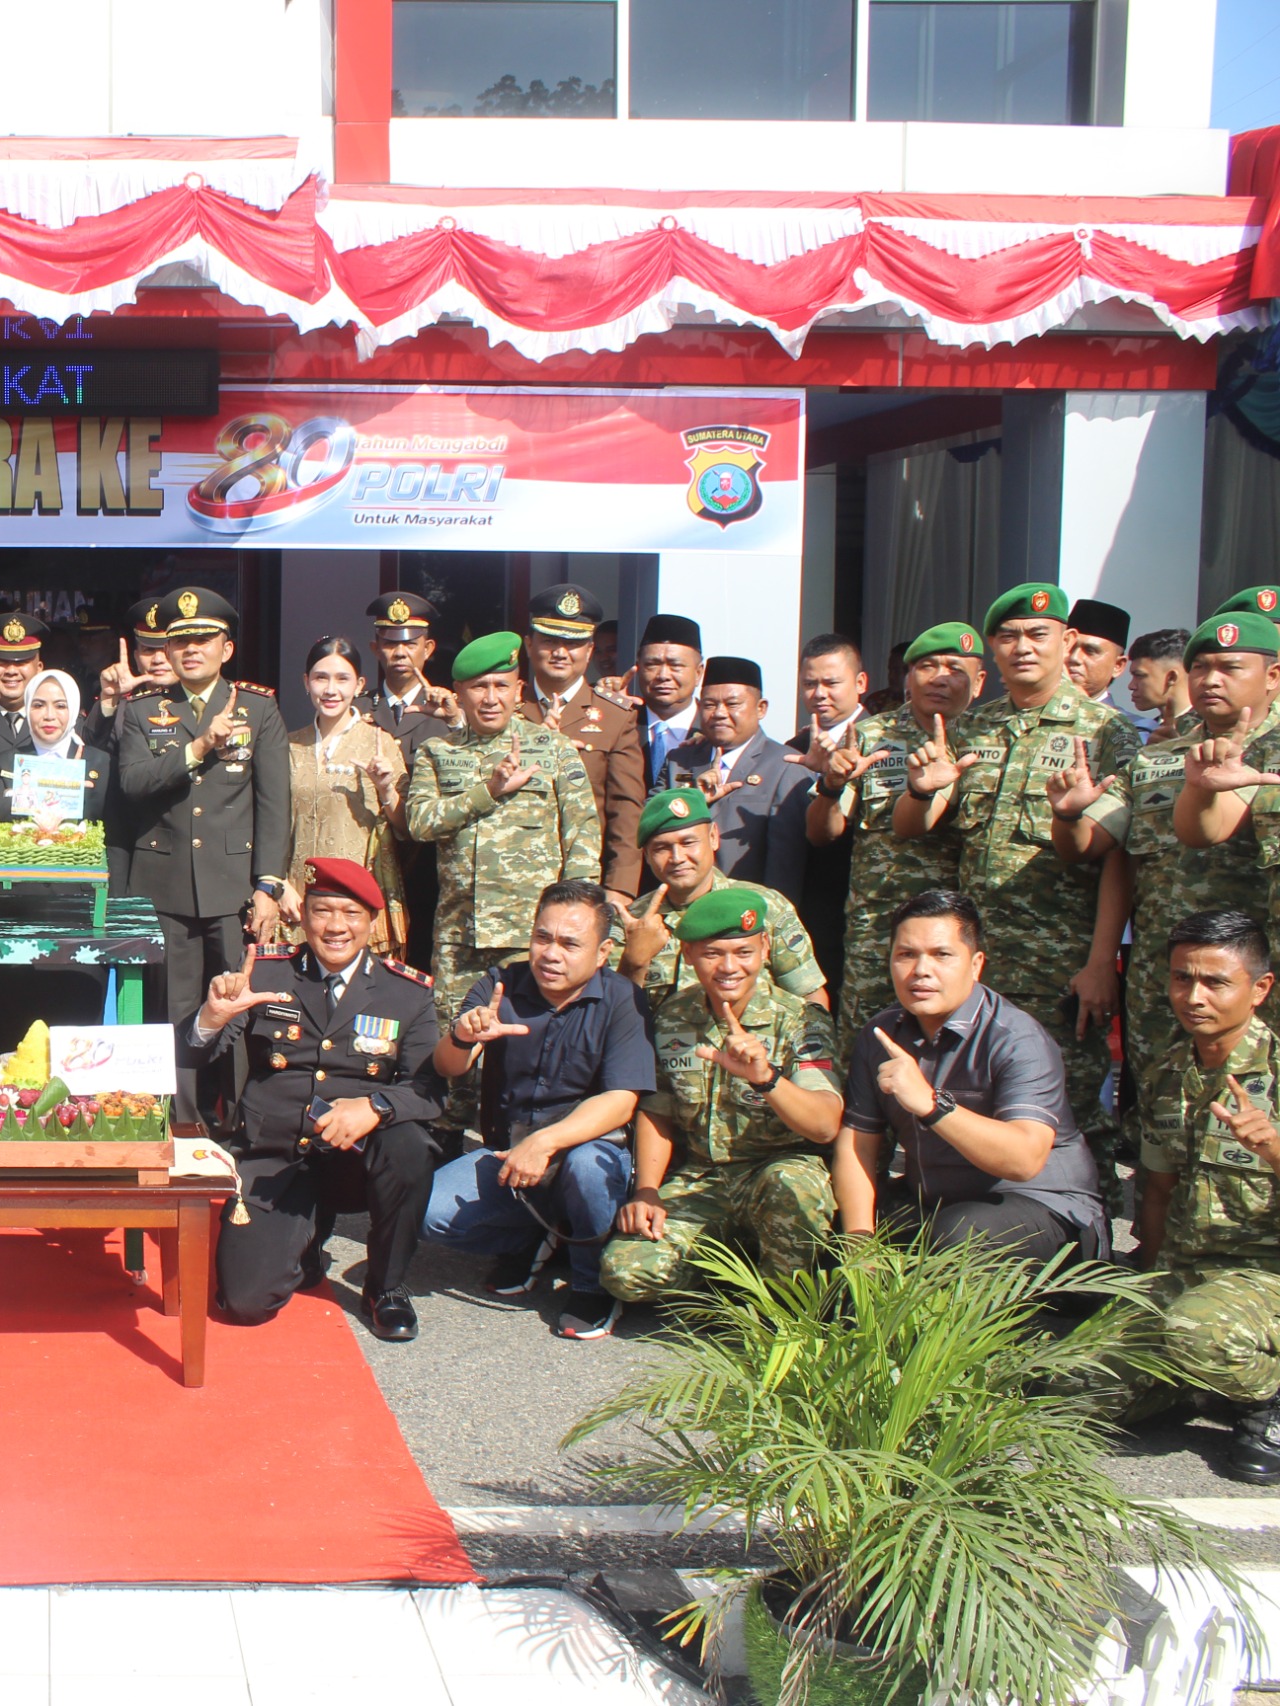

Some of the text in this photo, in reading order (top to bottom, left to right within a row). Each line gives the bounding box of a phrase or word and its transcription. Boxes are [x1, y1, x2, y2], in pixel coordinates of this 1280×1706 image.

[687, 430, 764, 446] SUMATERA UTARA
[76, 416, 165, 517] KE
[190, 413, 356, 526] 80
[412, 434, 507, 453] Mengabdi
[351, 464, 505, 502] POLRI
[354, 514, 493, 527] Untuk Masyarakat
[535, 759, 551, 769] AD
[1041, 756, 1065, 769] TNI
[1151, 768, 1185, 780] PASARIB
